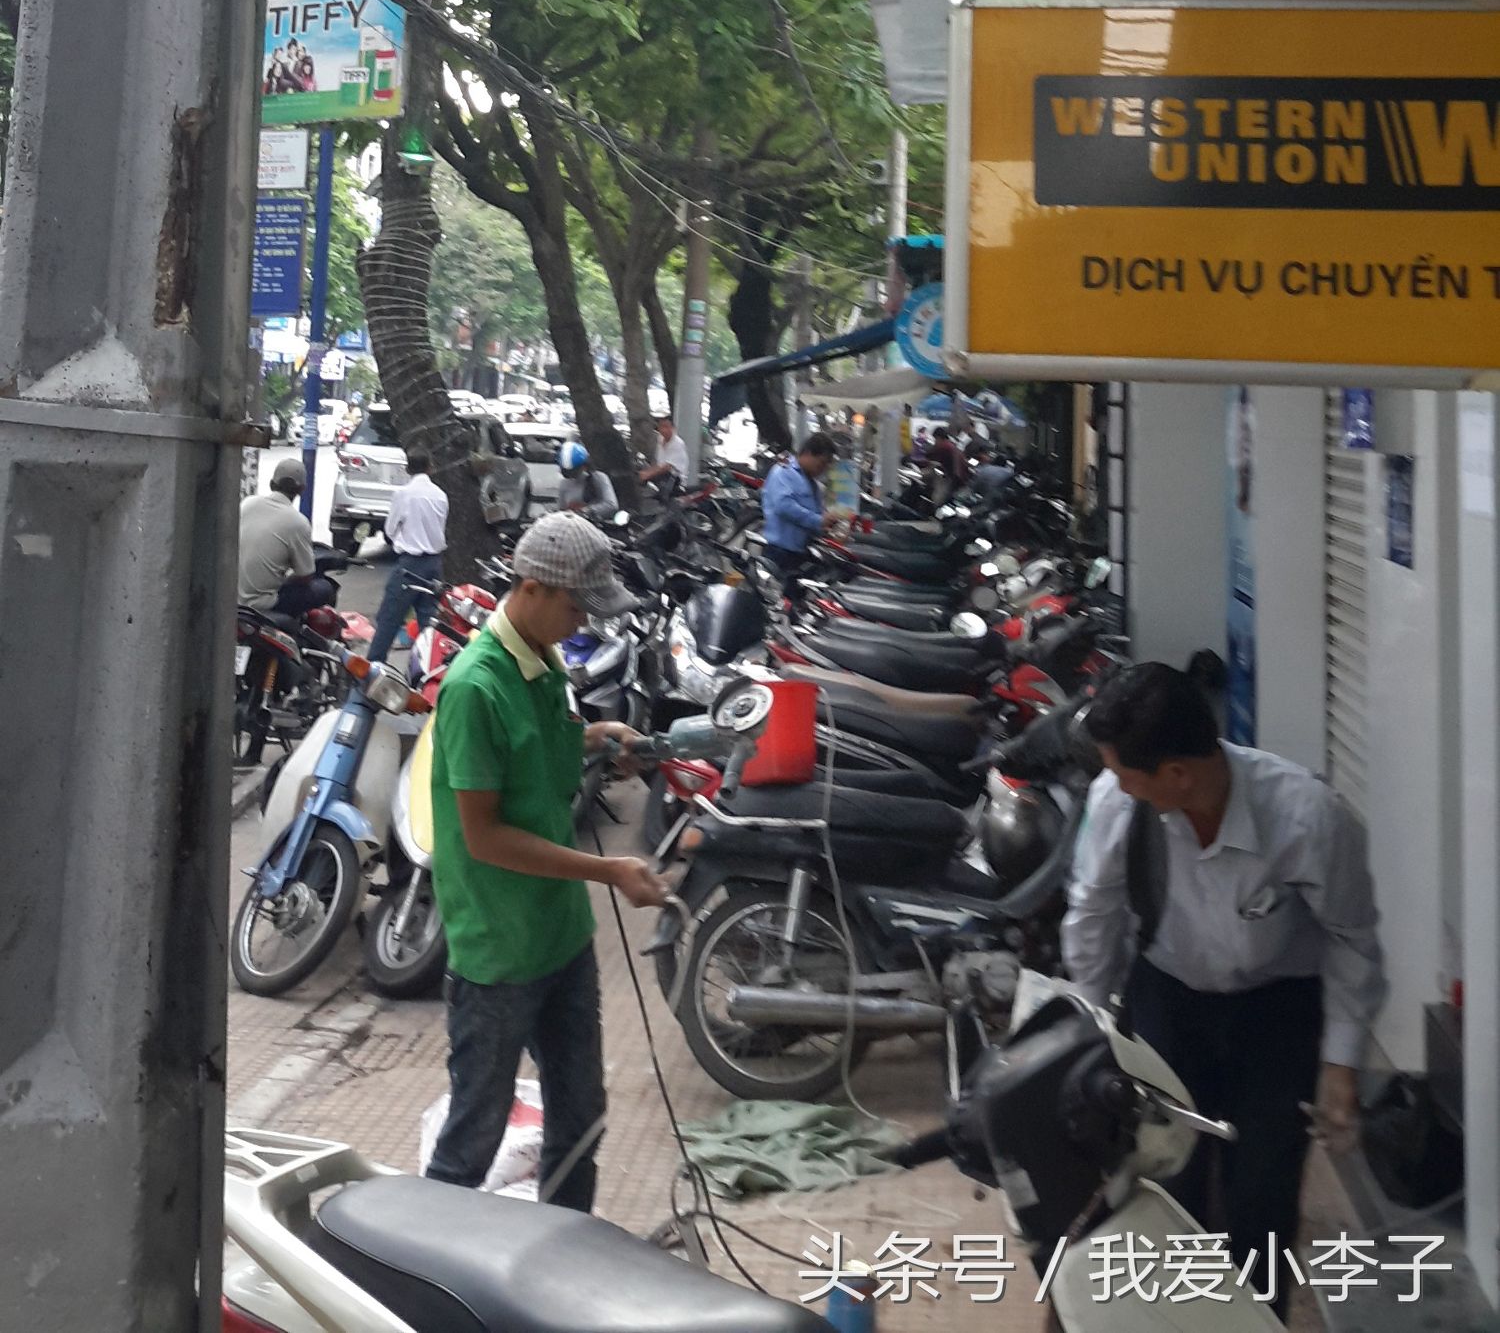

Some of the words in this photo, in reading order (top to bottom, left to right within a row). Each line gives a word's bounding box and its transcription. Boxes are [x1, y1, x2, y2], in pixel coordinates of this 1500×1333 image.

[269, 0, 368, 36] TIFFY
[1050, 96, 1367, 140] WESTERN
[1149, 141, 1368, 185] UNION
[1082, 254, 1185, 296] DỊCH
[1199, 260, 1263, 300] VỤ
